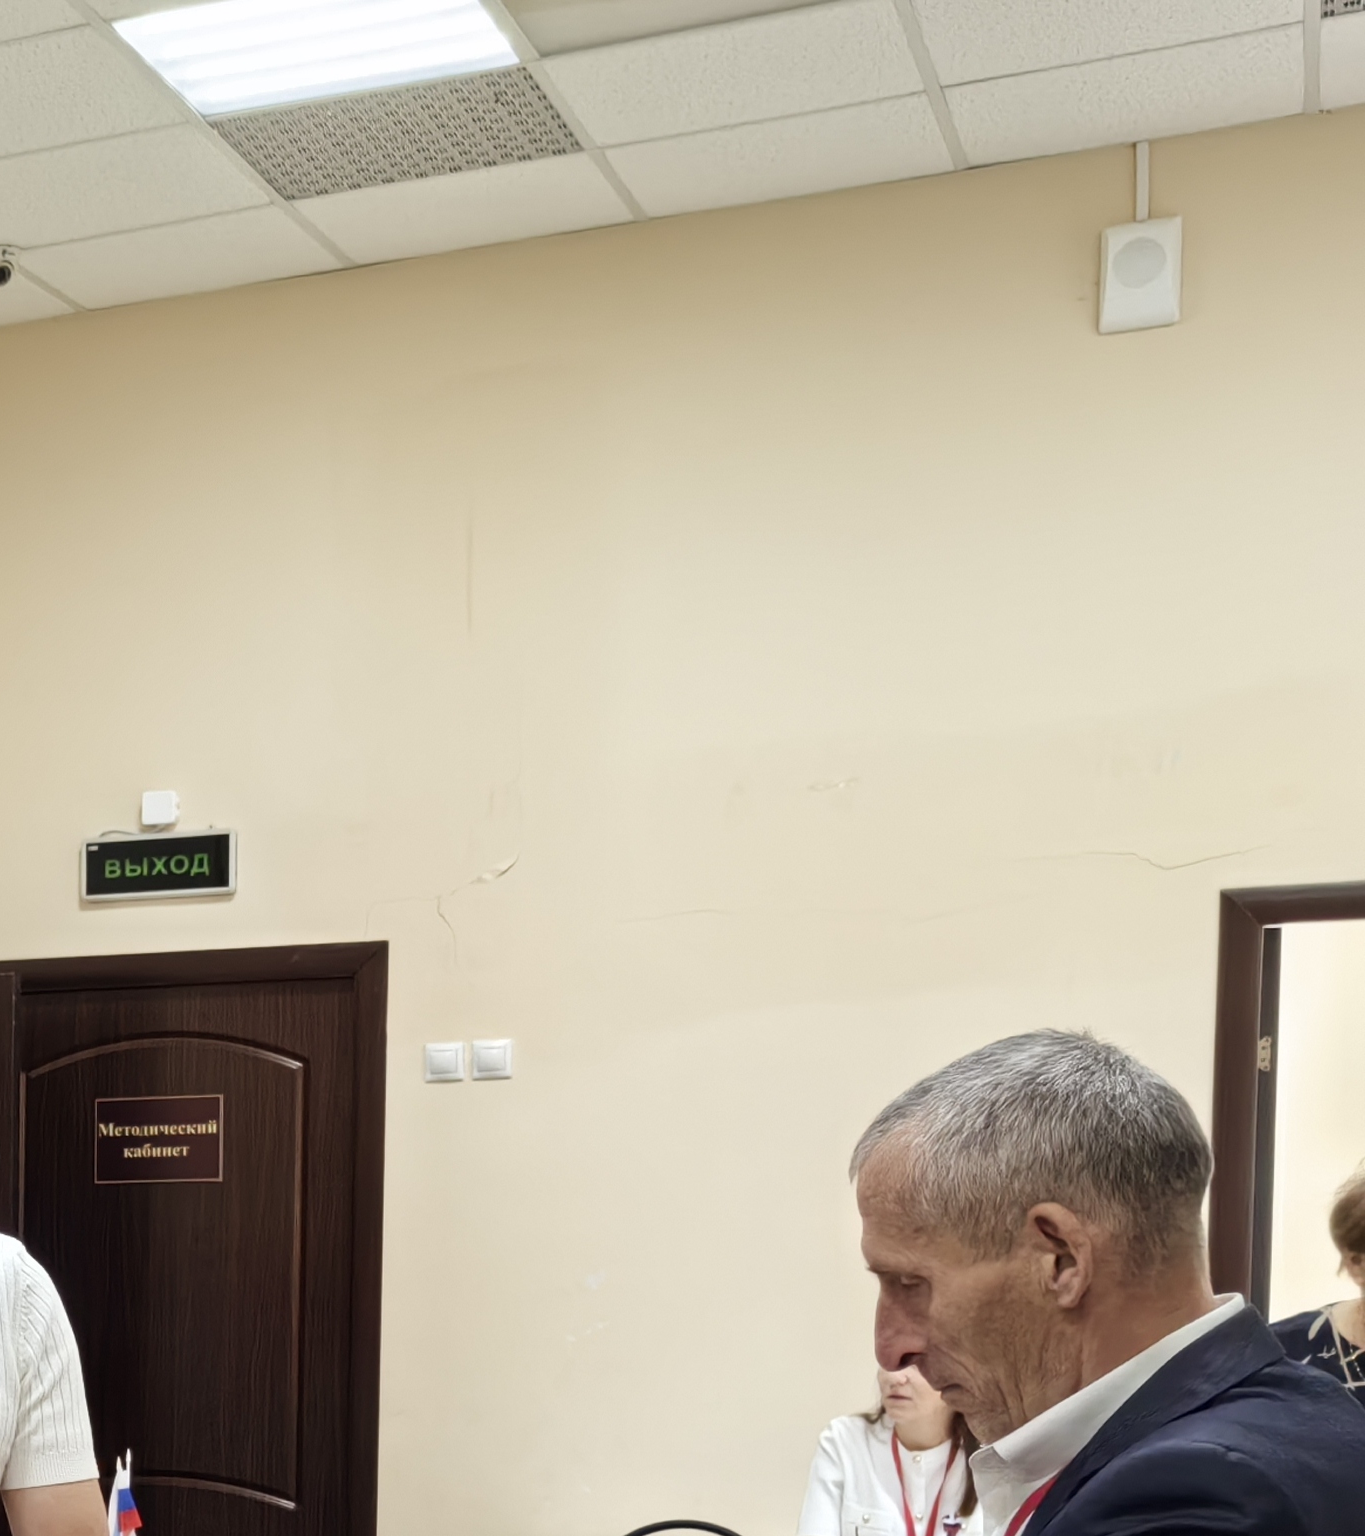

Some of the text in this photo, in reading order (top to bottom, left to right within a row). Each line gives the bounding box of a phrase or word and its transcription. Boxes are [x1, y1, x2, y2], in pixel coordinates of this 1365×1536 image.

[104, 853, 210, 878] ВЫХОД
[98, 1120, 218, 1138] Методический
[123, 1143, 190, 1159] кабинет
